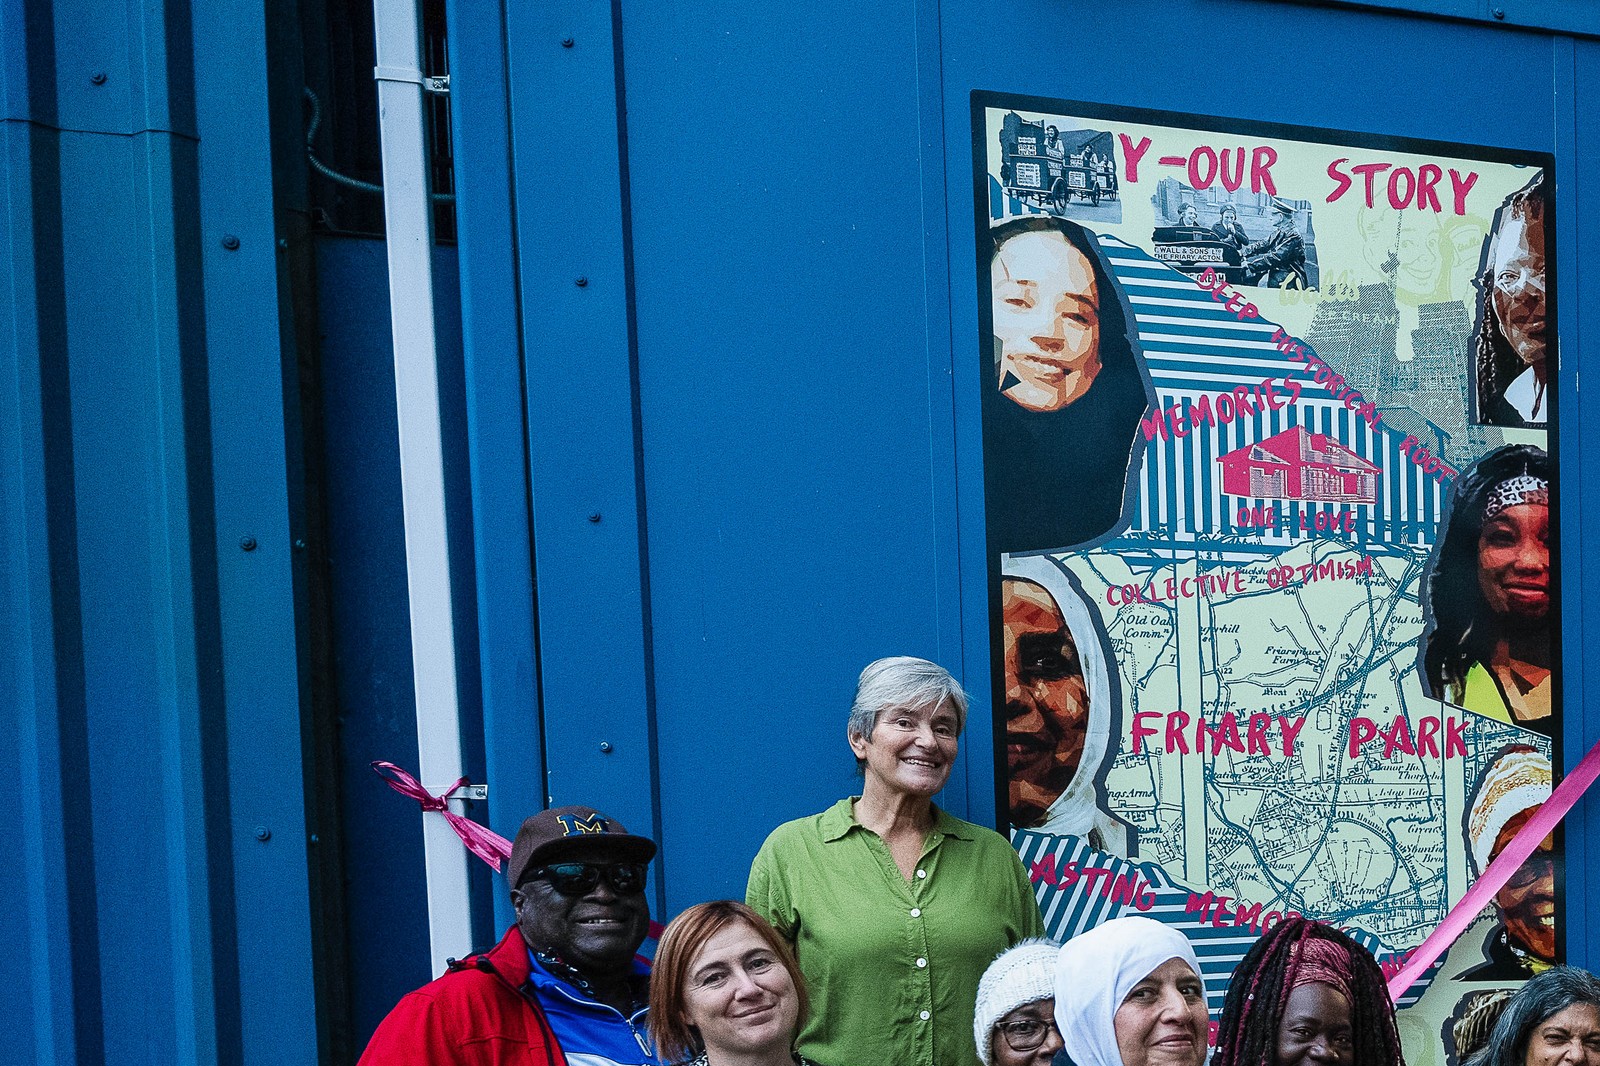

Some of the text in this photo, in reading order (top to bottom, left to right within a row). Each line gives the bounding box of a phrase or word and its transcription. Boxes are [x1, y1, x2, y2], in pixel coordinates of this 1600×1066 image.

[1118, 131, 1278, 197] Y-OUR
[1325, 157, 1479, 216] STORY
[1160, 246, 1180, 254] WALL
[1189, 247, 1209, 255] SONS
[1195, 266, 1458, 486] DEEP HISTORICAL ROOT
[1142, 374, 1303, 443] MEMORIES
[1237, 505, 1357, 533] ONE LOVE
[1106, 555, 1373, 607] COLLECTIVE OPTIMISM
[1126, 614, 1148, 625] Old
[1130, 710, 1471, 760] FRIARY PARK
[556, 813, 610, 837] M
[1030, 852, 1157, 912] ASTING
